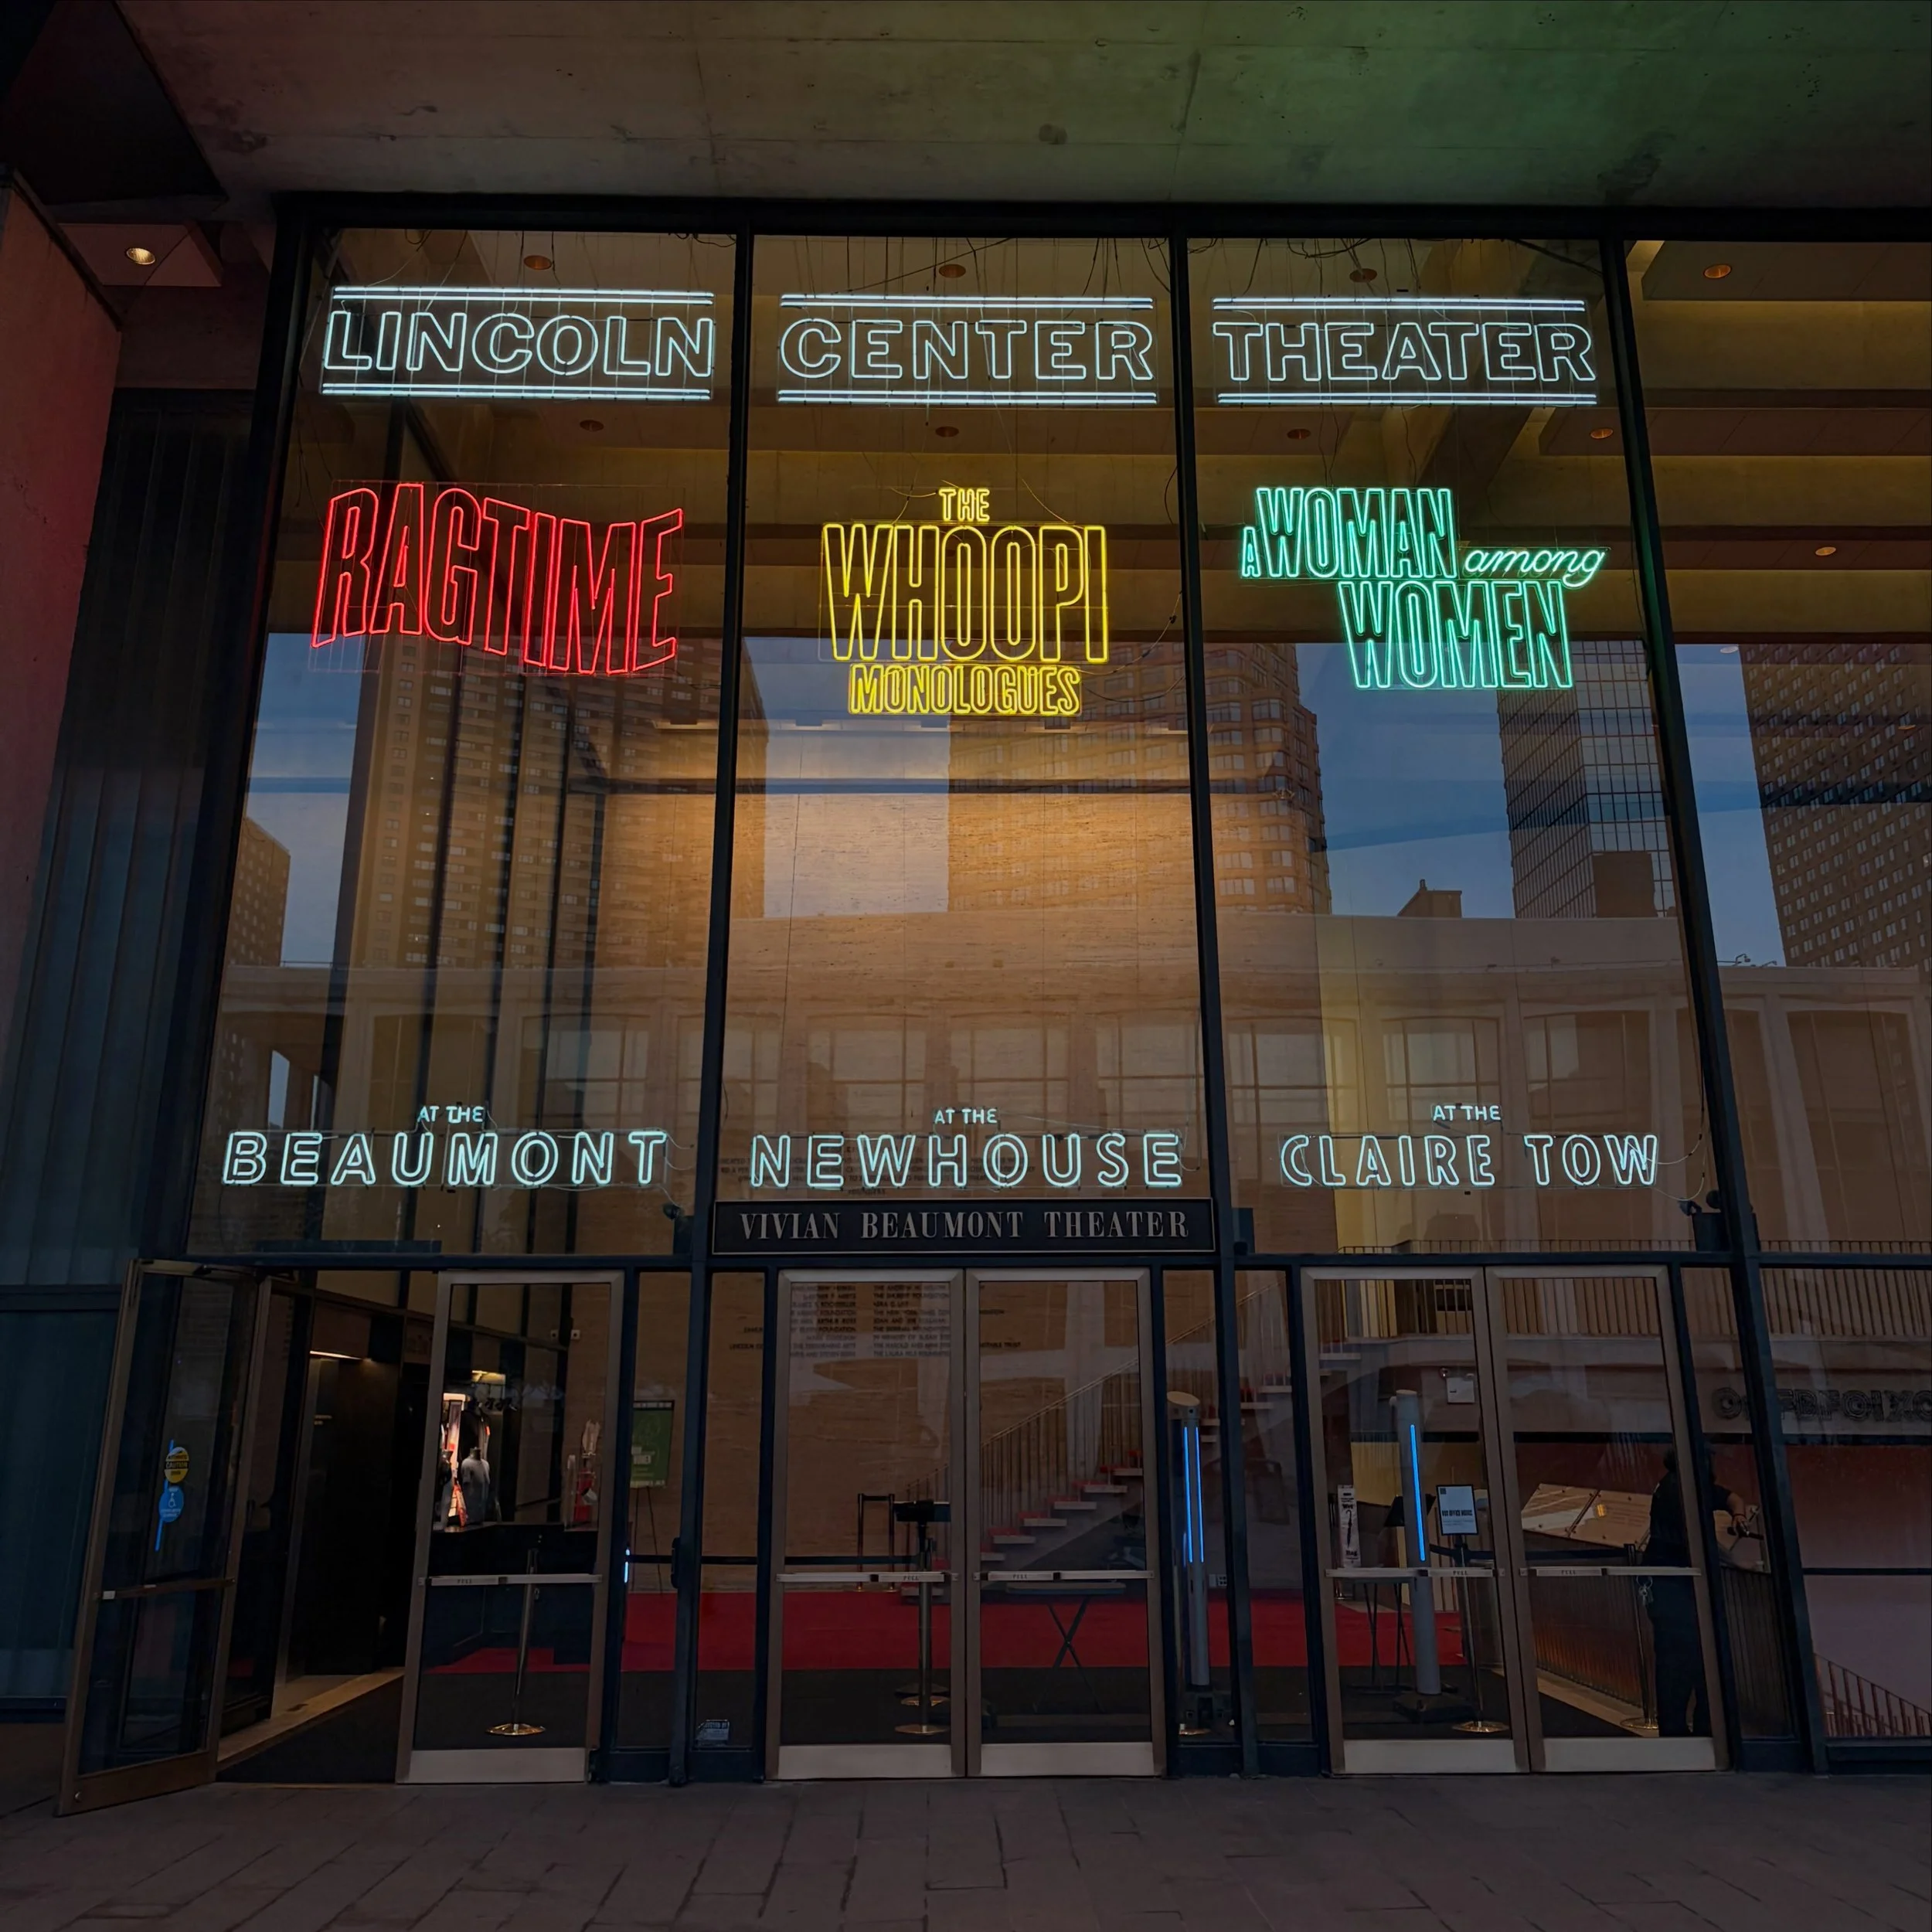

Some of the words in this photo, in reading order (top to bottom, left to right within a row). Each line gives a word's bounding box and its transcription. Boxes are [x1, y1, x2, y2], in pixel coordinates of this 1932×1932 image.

[324, 311, 713, 377] LINCOLN
[781, 318, 1154, 380] CENTER
[1213, 322, 1597, 382] THEATER
[938, 488, 991, 522] THE
[1241, 526, 1261, 578] A
[1256, 488, 1458, 579] WOMAN
[1462, 549, 1607, 589] among
[311, 483, 683, 675] RAGTIME
[822, 523, 1108, 663] WHOOPI
[1338, 580, 1573, 689] WOMEN
[849, 664, 1081, 715] MONOLOGUES
[417, 1105, 439, 1123] AT
[446, 1105, 485, 1124] THE
[934, 1108, 955, 1124] AT
[962, 1108, 998, 1124] THE
[1433, 1104, 1457, 1121] AT
[1459, 1105, 1502, 1121] THE
[222, 1131, 668, 1186] BEAUMONT
[750, 1133, 1182, 1189] NEWHOUSE
[1280, 1134, 1495, 1186] CLAIRE
[1524, 1134, 1658, 1186] TOW
[740, 1213, 842, 1240] VIVIAN
[861, 1211, 1023, 1239] BEAUMONT
[1044, 1211, 1189, 1238] THEATER
